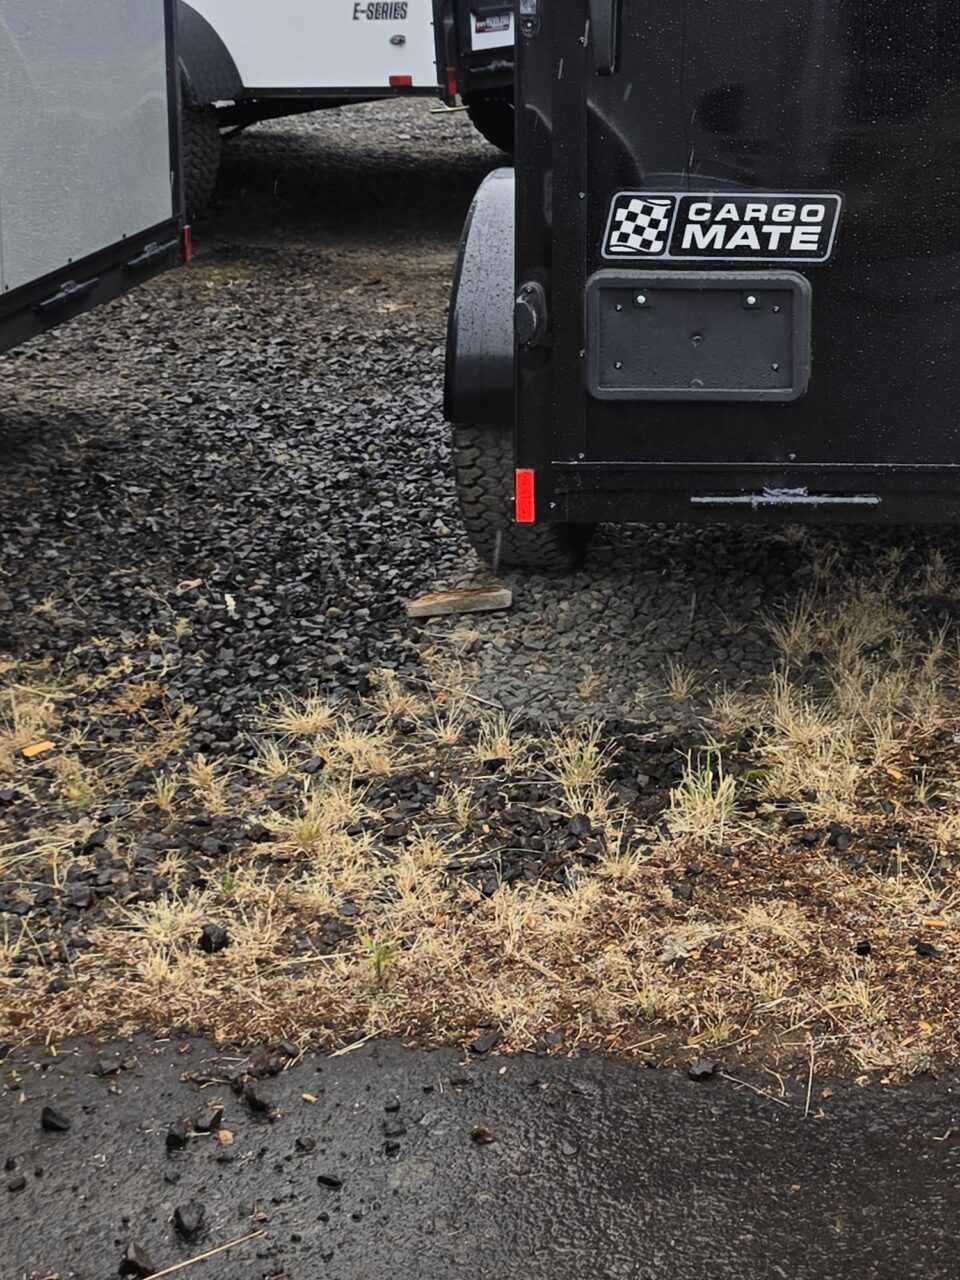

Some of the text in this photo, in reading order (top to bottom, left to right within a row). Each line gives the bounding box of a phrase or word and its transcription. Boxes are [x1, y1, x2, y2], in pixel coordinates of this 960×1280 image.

[353, 1, 408, 20] E-SERIES
[688, 202, 826, 222] CARGO
[681, 224, 822, 251] MATE
